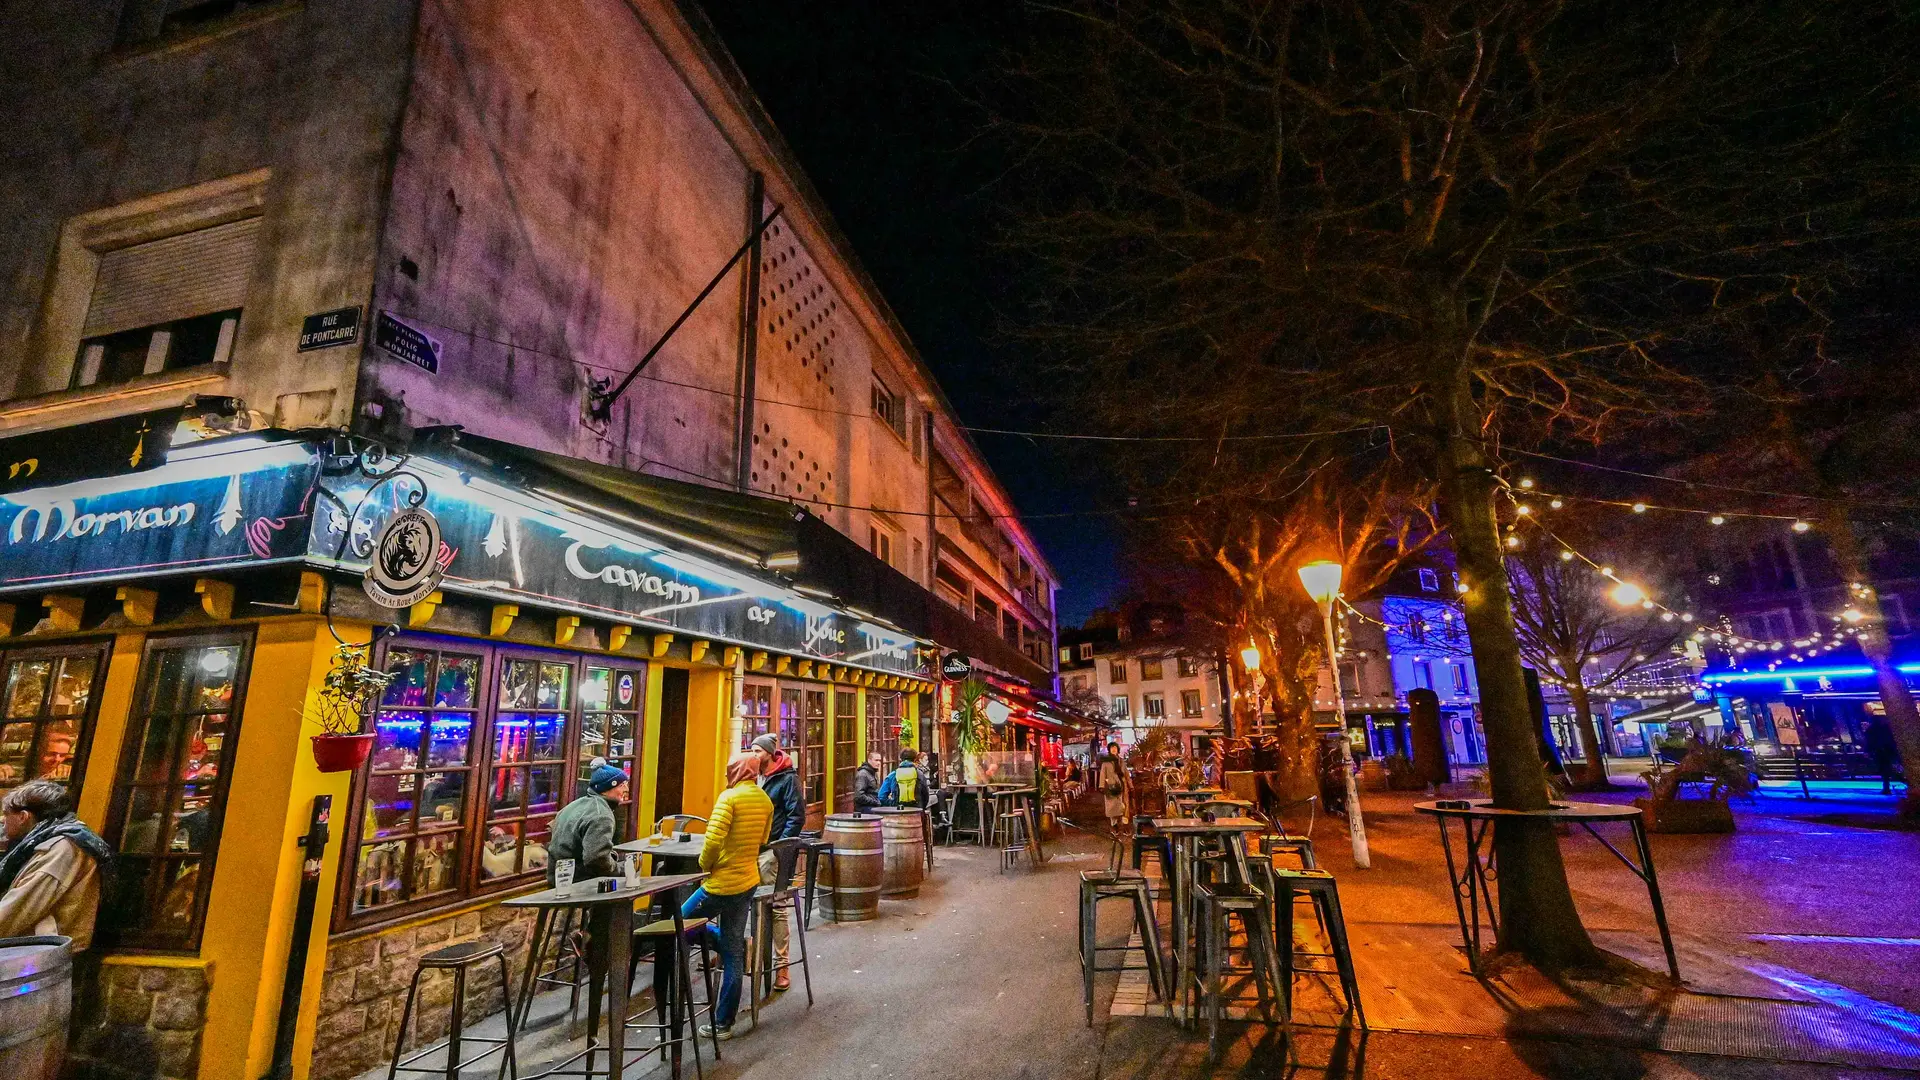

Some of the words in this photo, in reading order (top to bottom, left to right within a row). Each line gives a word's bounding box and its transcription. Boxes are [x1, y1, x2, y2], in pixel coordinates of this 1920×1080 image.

[322, 314, 339, 327] RUE
[301, 334, 311, 345] DE
[312, 326, 355, 342] PONTCARRE
[395, 335, 419, 353] POLIG
[383, 340, 430, 368] MONJARRET
[4, 497, 196, 546] Morvan
[413, 582, 436, 601] Morvan
[747, 605, 776, 625] ar
[943, 665, 968, 673] GUINNESS
